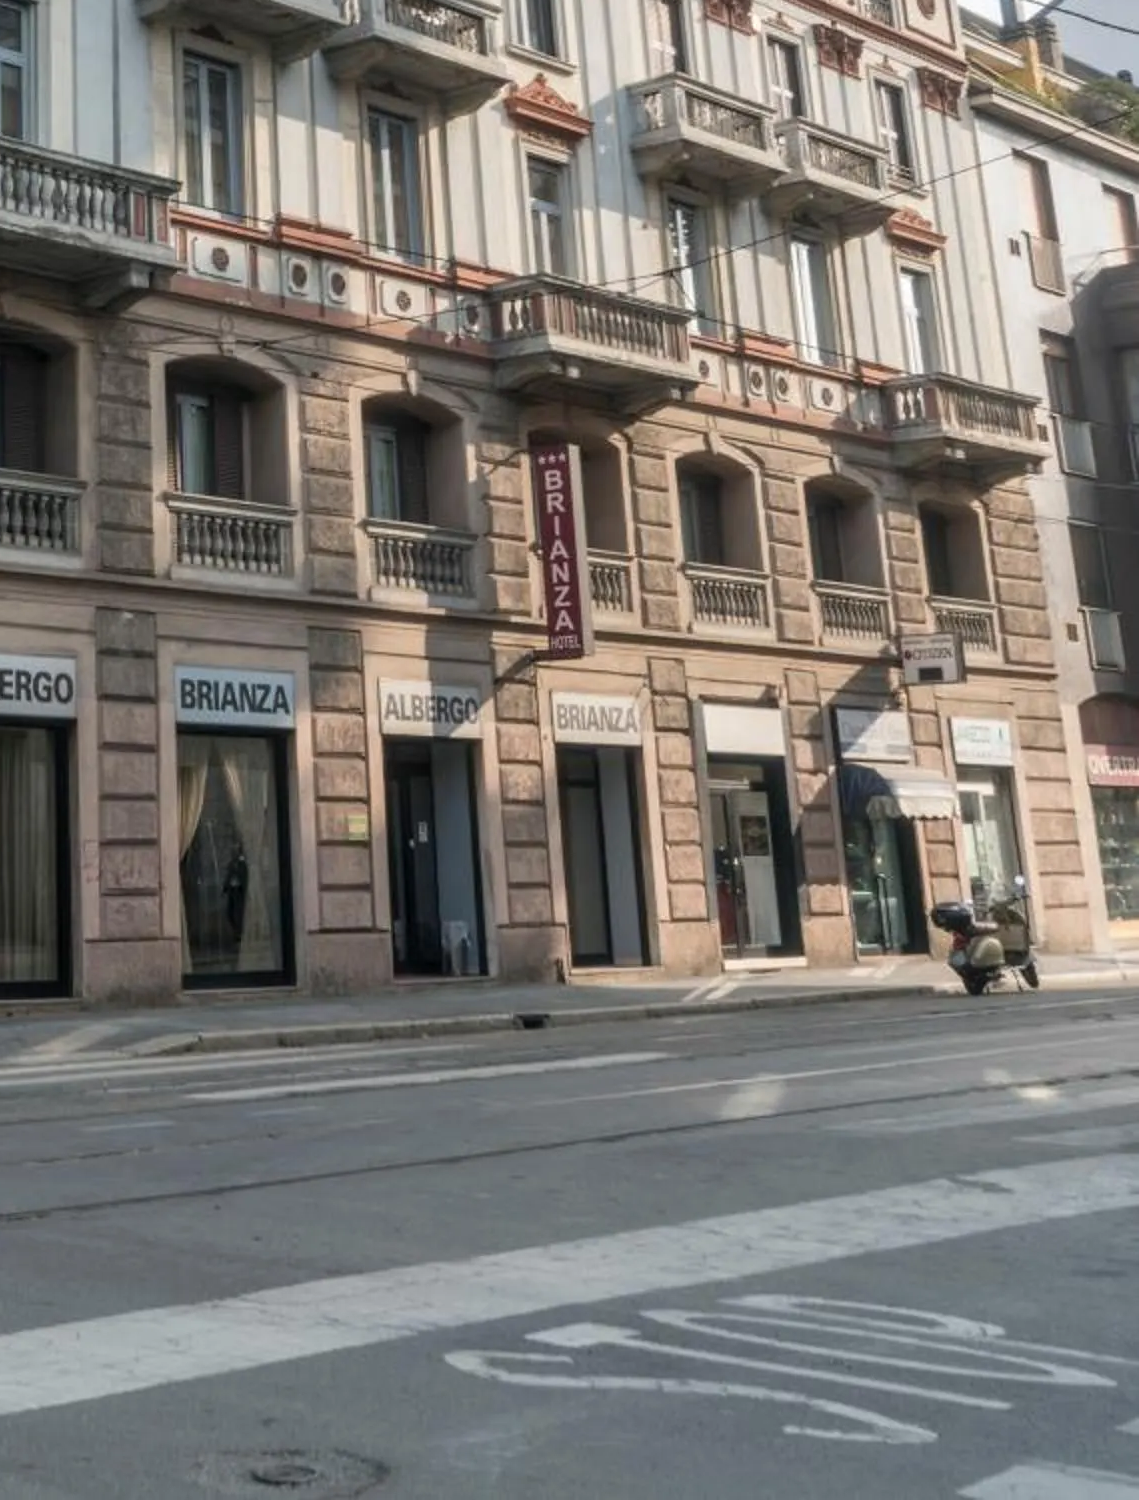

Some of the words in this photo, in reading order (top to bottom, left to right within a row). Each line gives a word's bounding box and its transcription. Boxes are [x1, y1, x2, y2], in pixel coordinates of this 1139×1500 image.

[543, 468, 575, 632] BRIANZA
[550, 634, 582, 651] HOTEL
[180, 678, 291, 716] BRIANZA
[384, 691, 479, 725] ALBERGO
[556, 703, 639, 734] BRIANZA
